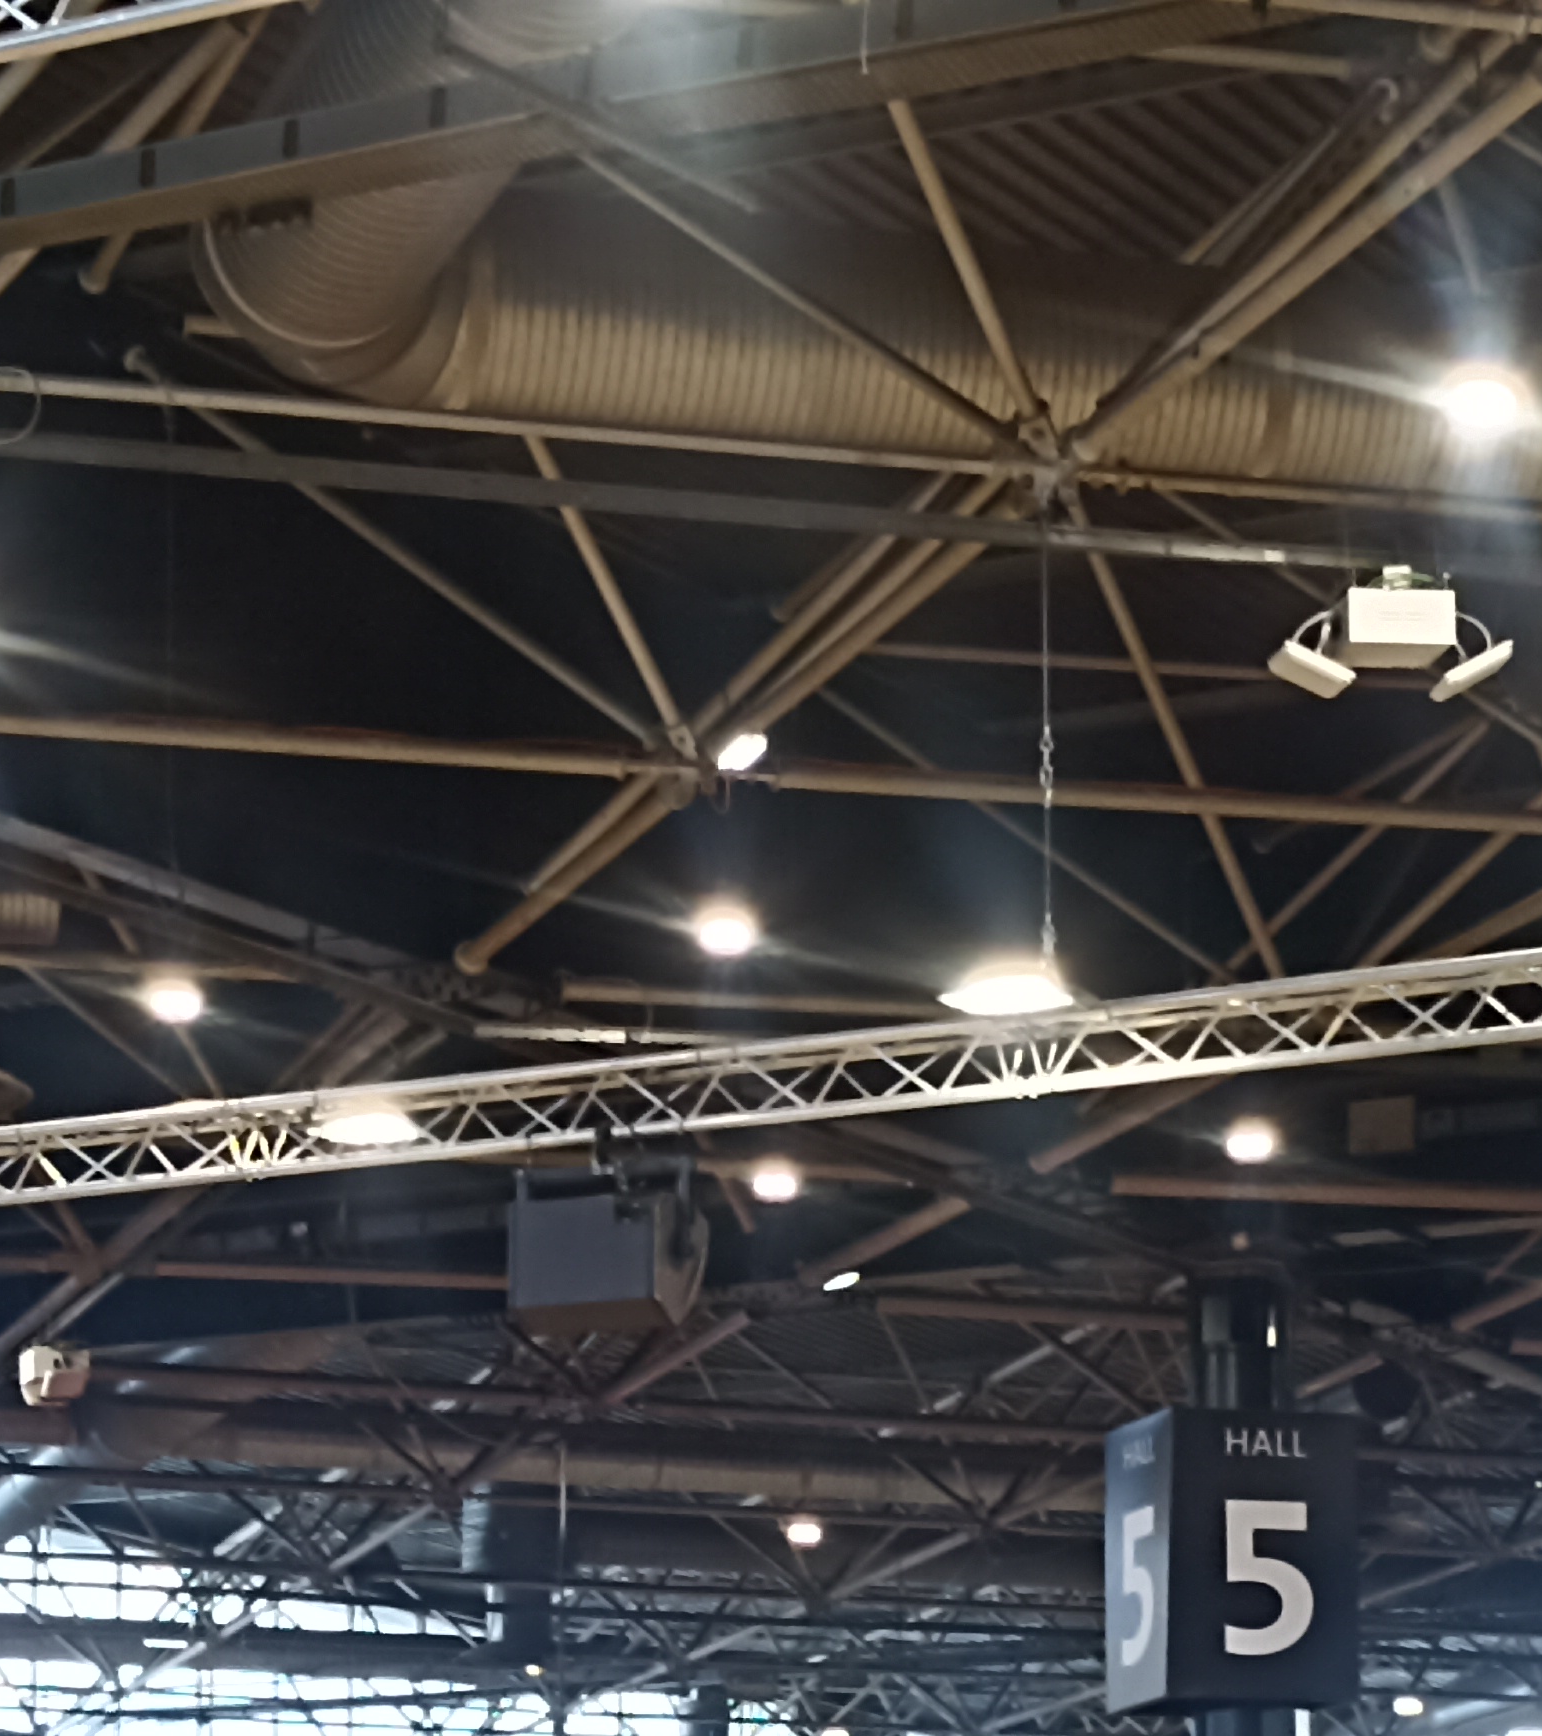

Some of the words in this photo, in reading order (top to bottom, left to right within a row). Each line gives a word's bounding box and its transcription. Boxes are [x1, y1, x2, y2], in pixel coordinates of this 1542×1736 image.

[1225, 1427, 1307, 1459] HALL
[1121, 1504, 1156, 1668] 5
[1224, 1498, 1314, 1656] 5
